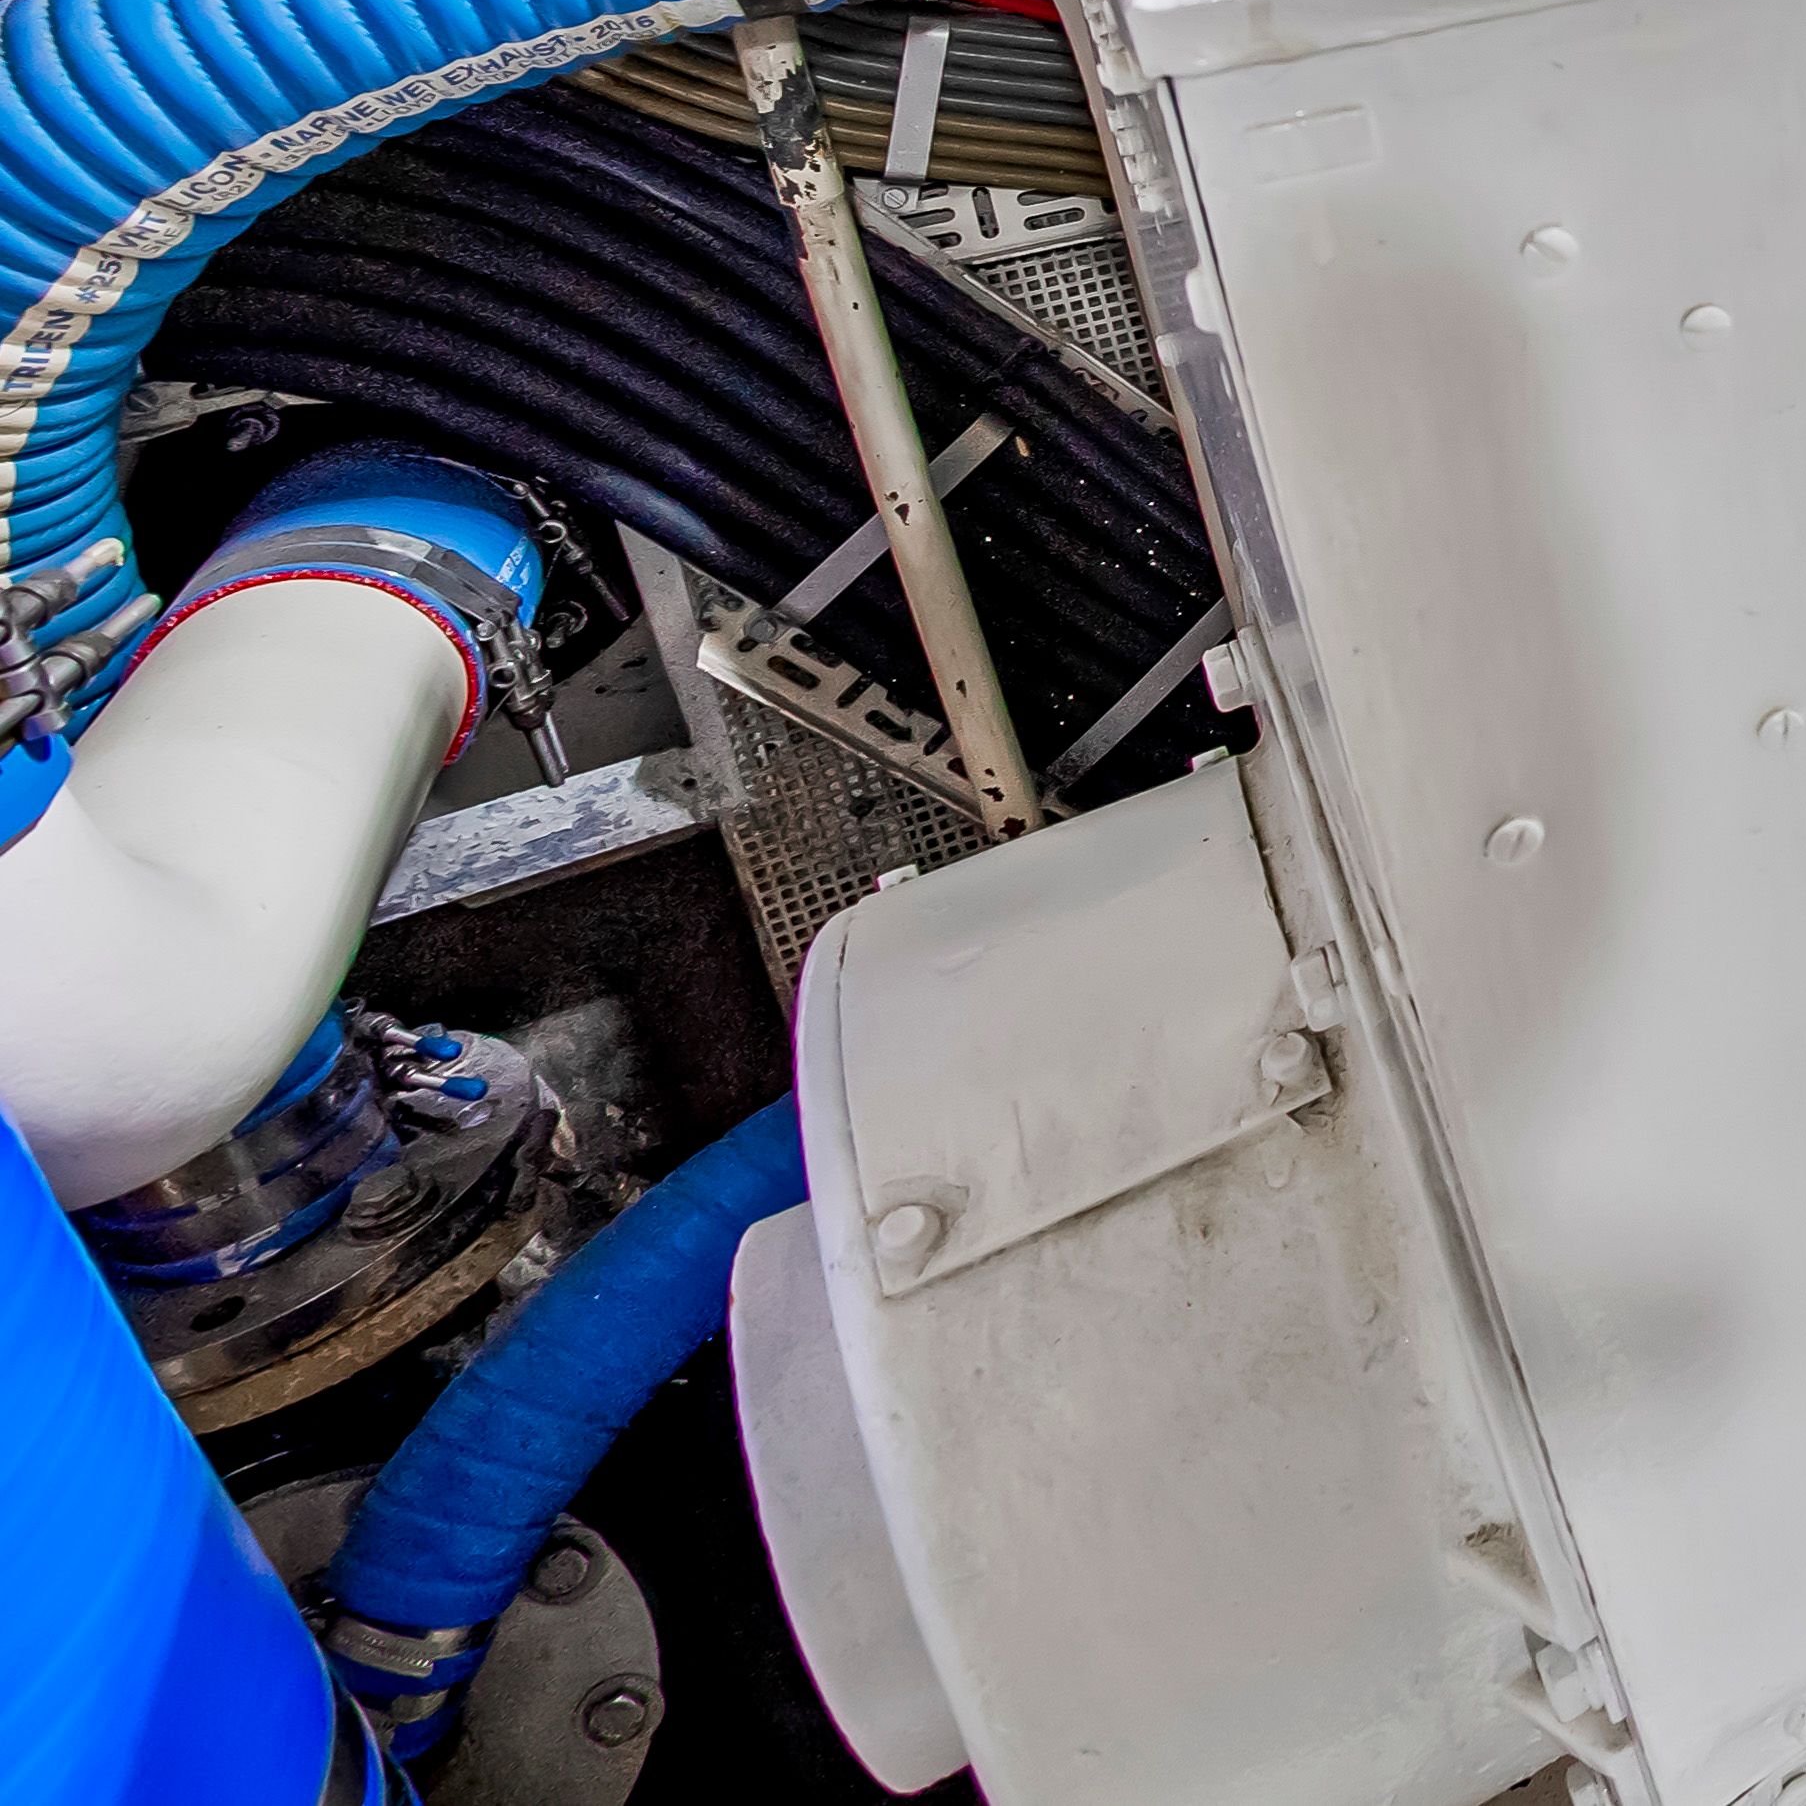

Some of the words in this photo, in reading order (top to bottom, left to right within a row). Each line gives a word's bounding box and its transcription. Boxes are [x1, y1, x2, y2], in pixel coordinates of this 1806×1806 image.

[109, 210, 169, 249] VHT
[440, 34, 570, 86] EXHAUST
[590, 14, 656, 39] 2016
